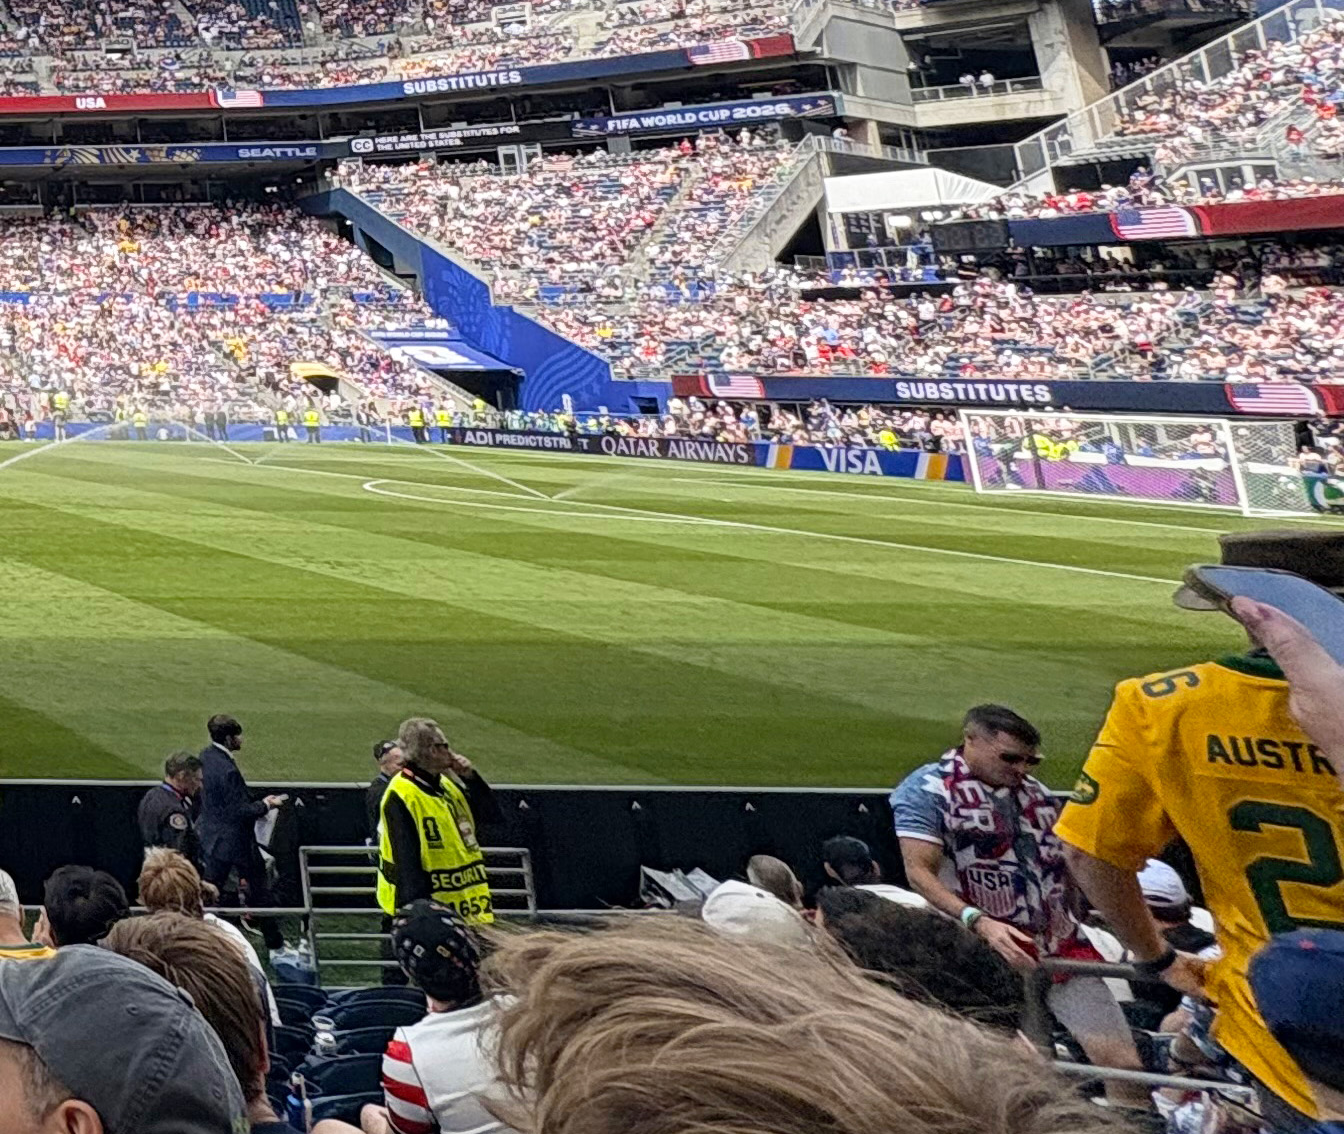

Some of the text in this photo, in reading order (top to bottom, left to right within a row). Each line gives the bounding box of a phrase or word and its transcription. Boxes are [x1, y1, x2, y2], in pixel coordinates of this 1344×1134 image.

[403, 70, 522, 96] SUBSTITUTES
[76, 97, 106, 109] USA
[607, 103, 791, 131] FIFA WORLD CUP 2026
[500, 126, 520, 134] FOR
[238, 147, 317, 159] SEATTLE
[896, 382, 1051, 402] SUBSTITUTES
[464, 431, 589, 450] ADI PREDICTSTRT
[601, 436, 749, 463] QATAR AIRWAYS
[816, 446, 883, 475] VISA
[1208, 734, 1338, 776] AUSTR
[432, 864, 489, 890] SECURIT
[969, 869, 1011, 892] USA
